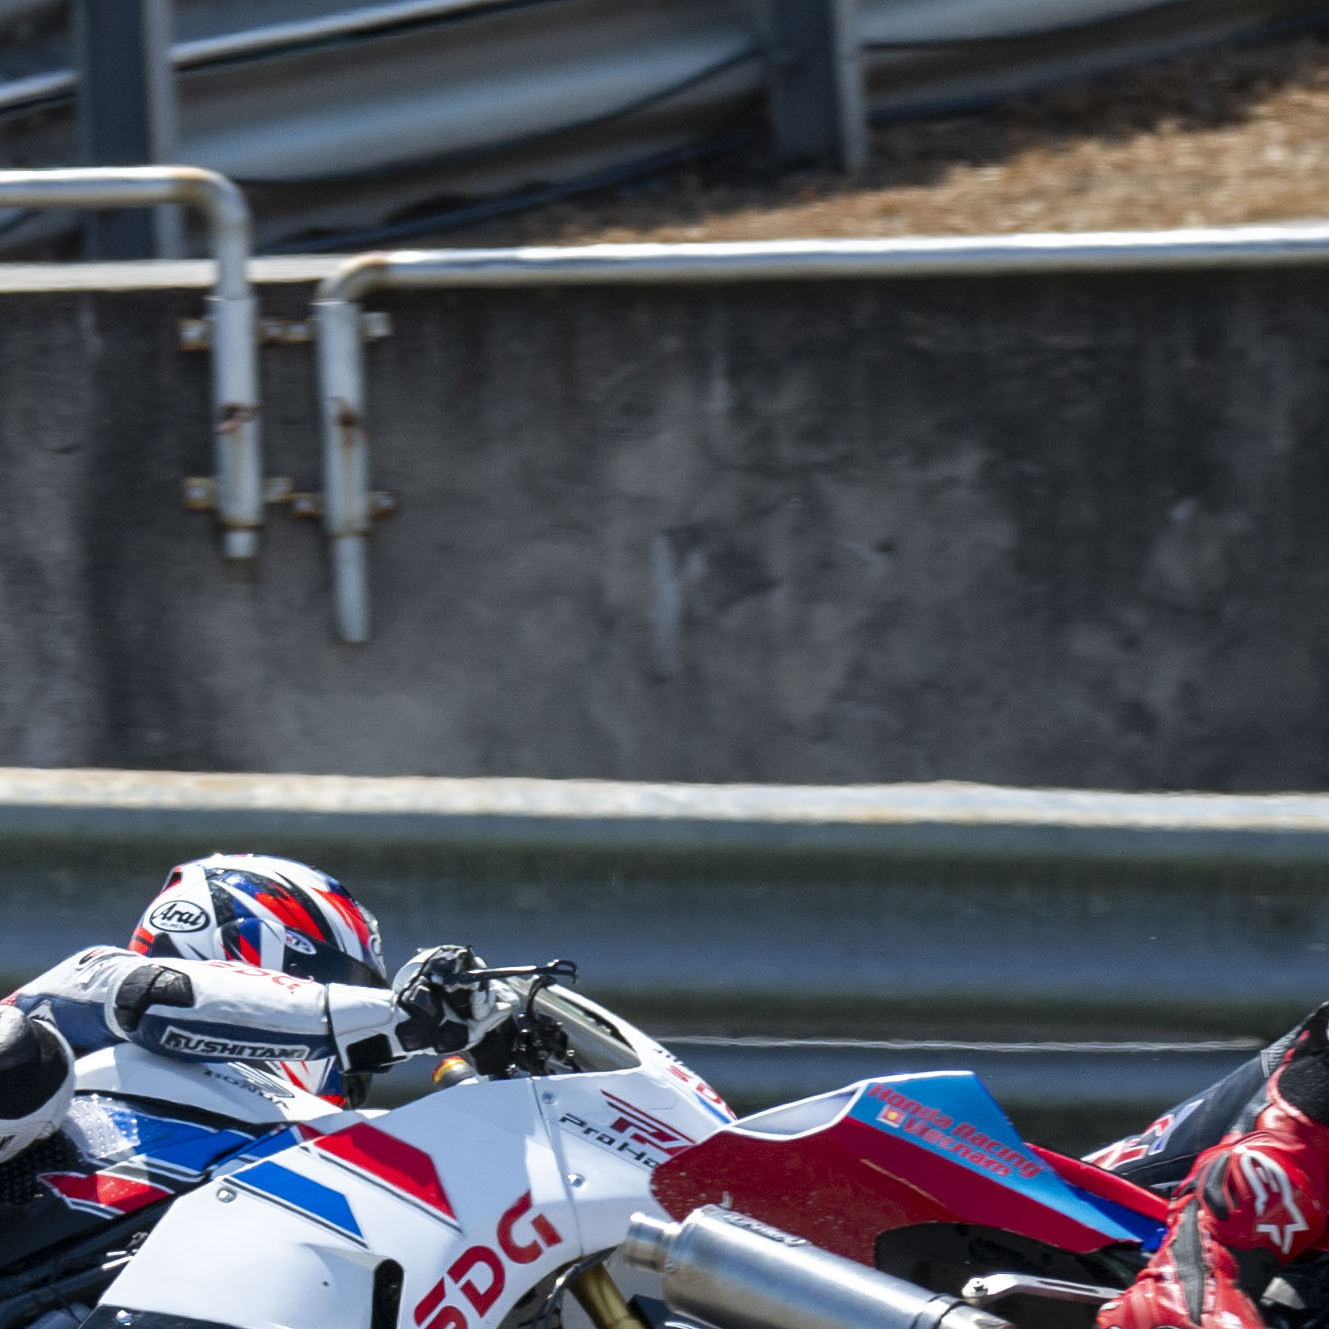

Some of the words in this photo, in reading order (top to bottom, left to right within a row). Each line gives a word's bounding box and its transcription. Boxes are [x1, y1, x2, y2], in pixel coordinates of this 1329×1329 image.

[153, 902, 204, 926] Arai
[868, 1083, 954, 1130] Honda
[951, 1122, 1043, 1179] Racing
[903, 1117, 1011, 1176] Vietnam
